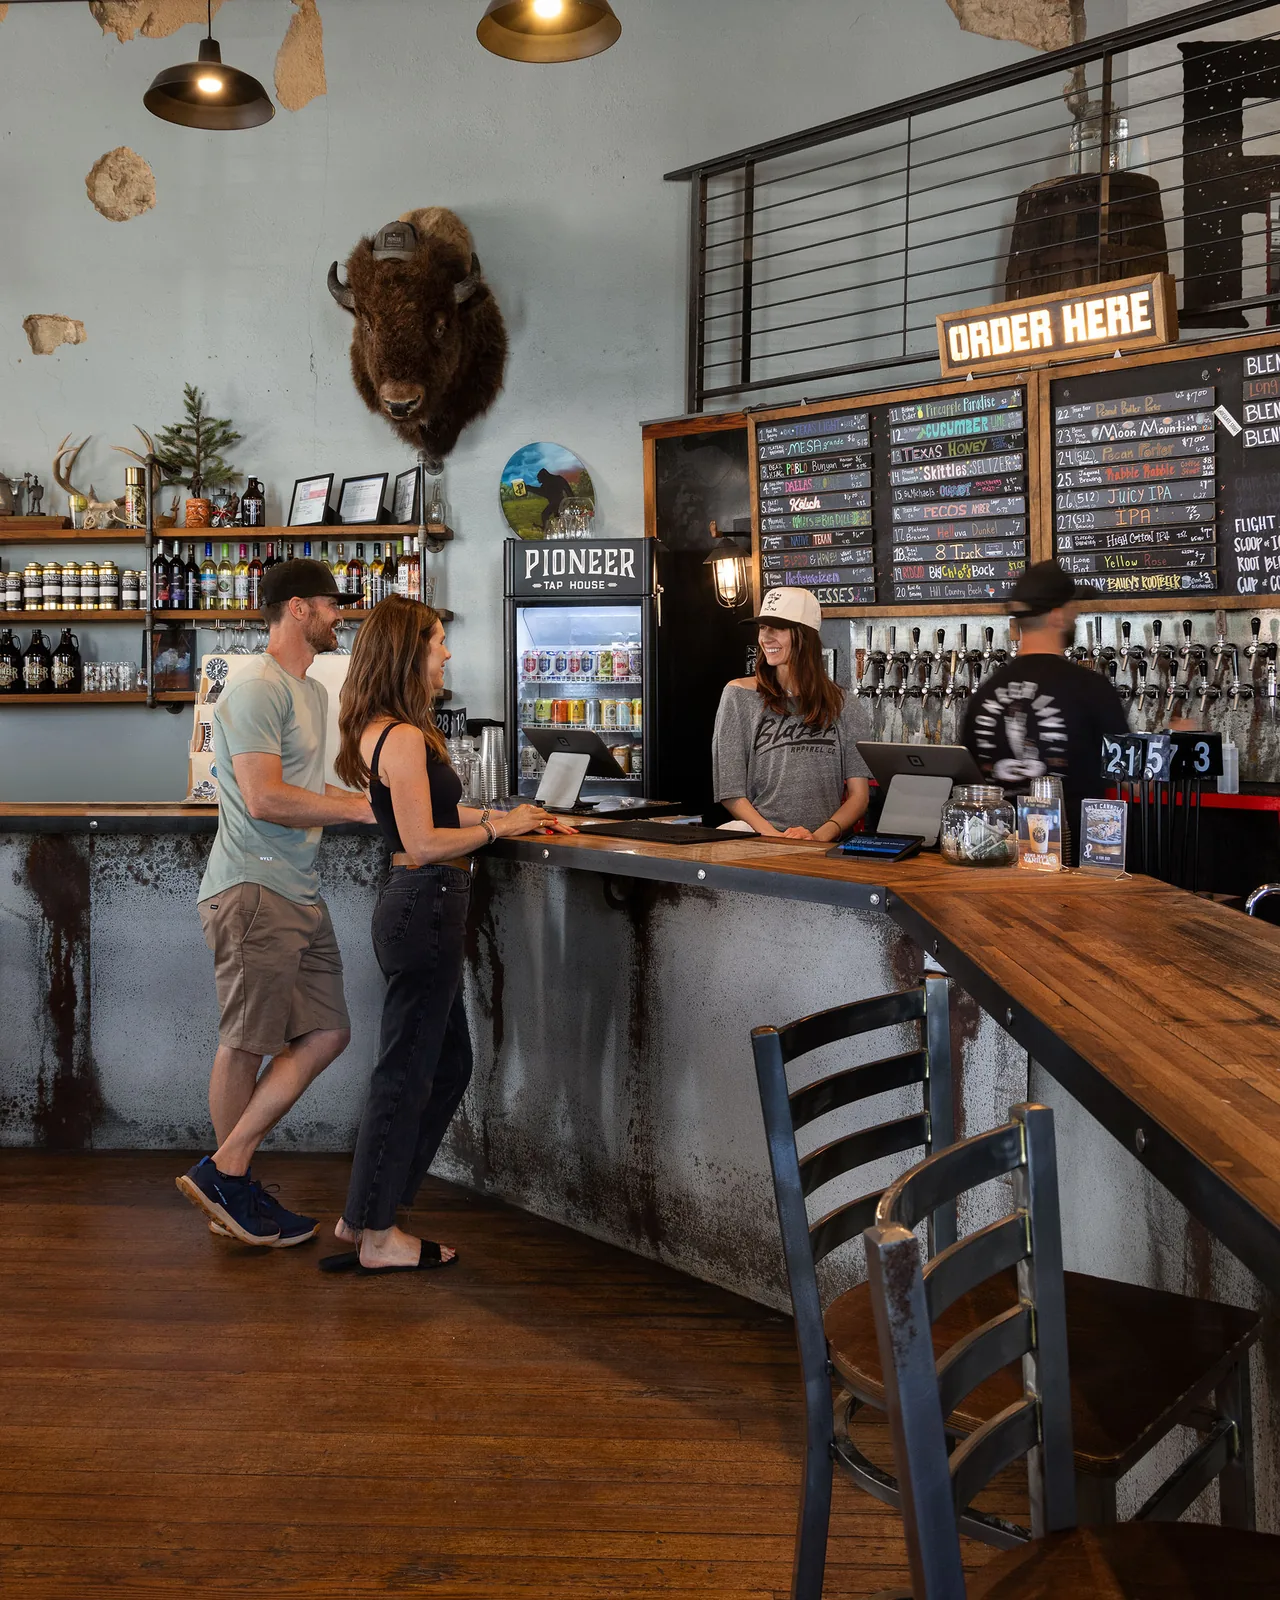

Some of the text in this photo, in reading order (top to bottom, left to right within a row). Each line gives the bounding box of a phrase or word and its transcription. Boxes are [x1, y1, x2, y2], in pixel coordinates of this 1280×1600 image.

[949, 290, 1151, 361] ORDER HERE
[925, 401, 961, 418] Pineapple
[963, 395, 996, 411] Paradise
[1095, 403, 1118, 418] Peanut
[1121, 401, 1141, 415] Butter
[1144, 396, 1162, 412] Porter
[902, 412, 916, 421] Cider
[925, 417, 989, 437] CUCUMBER
[1098, 423, 1137, 440] Moon
[1139, 419, 1198, 436] Mountian
[787, 439, 822, 456] MESA
[823, 438, 845, 452] grande
[901, 445, 943, 462] TEXAS
[948, 439, 987, 456] HONEY
[1074, 449, 1096, 463] (512)
[1101, 447, 1134, 462] Pecan
[1138, 442, 1175, 458] Porter
[786, 463, 808, 475] PABLO
[812, 461, 838, 474] Bunyan
[923, 464, 967, 480] Skittles
[971, 456, 1011, 475] SELTZER
[1105, 468, 1140, 481] Rabble
[1143, 464, 1175, 479] Rabble
[785, 479, 812, 493] DALLAS
[1078, 476, 1102, 484] Brewing
[1074, 491, 1099, 504] (512)
[1148, 486, 1172, 501] IPA
[923, 504, 967, 518] PECOS
[971, 502, 990, 515] AMBER
[1073, 513, 1095, 524] (512)
[1115, 508, 1151, 526] IPA
[937, 525, 967, 539] Helluva
[971, 522, 997, 536] Dunkel
[1235, 515, 1276, 533] FLIGHT
[813, 533, 832, 546] TEXAN
[1106, 534, 1128, 548] HIGH
[1156, 531, 1170, 543] IPA
[1234, 536, 1263, 552] SCOOP
[935, 544, 946, 560] 8
[950, 543, 984, 560] Track
[525, 548, 636, 579] PIONEER
[809, 556, 816, 566] &
[1104, 555, 1138, 568] Yellow
[1143, 554, 1167, 567] Rose
[1237, 556, 1260, 572] ROOT
[785, 570, 840, 585] Hefeweizen
[942, 563, 972, 579] Chief's
[972, 564, 995, 577] Bock
[544, 581, 605, 590] TAP HOUSE
[929, 586, 941, 597] Hill
[944, 586, 966, 597] Country
[967, 584, 982, 595] Bock
[1237, 576, 1258, 594] CUP
[456, 713, 465, 732] 12
[791, 745, 824, 753] APPAREL
[1146, 742, 1163, 773] 5
[1194, 742, 1210, 772] 3
[1107, 742, 1135, 776] 21
